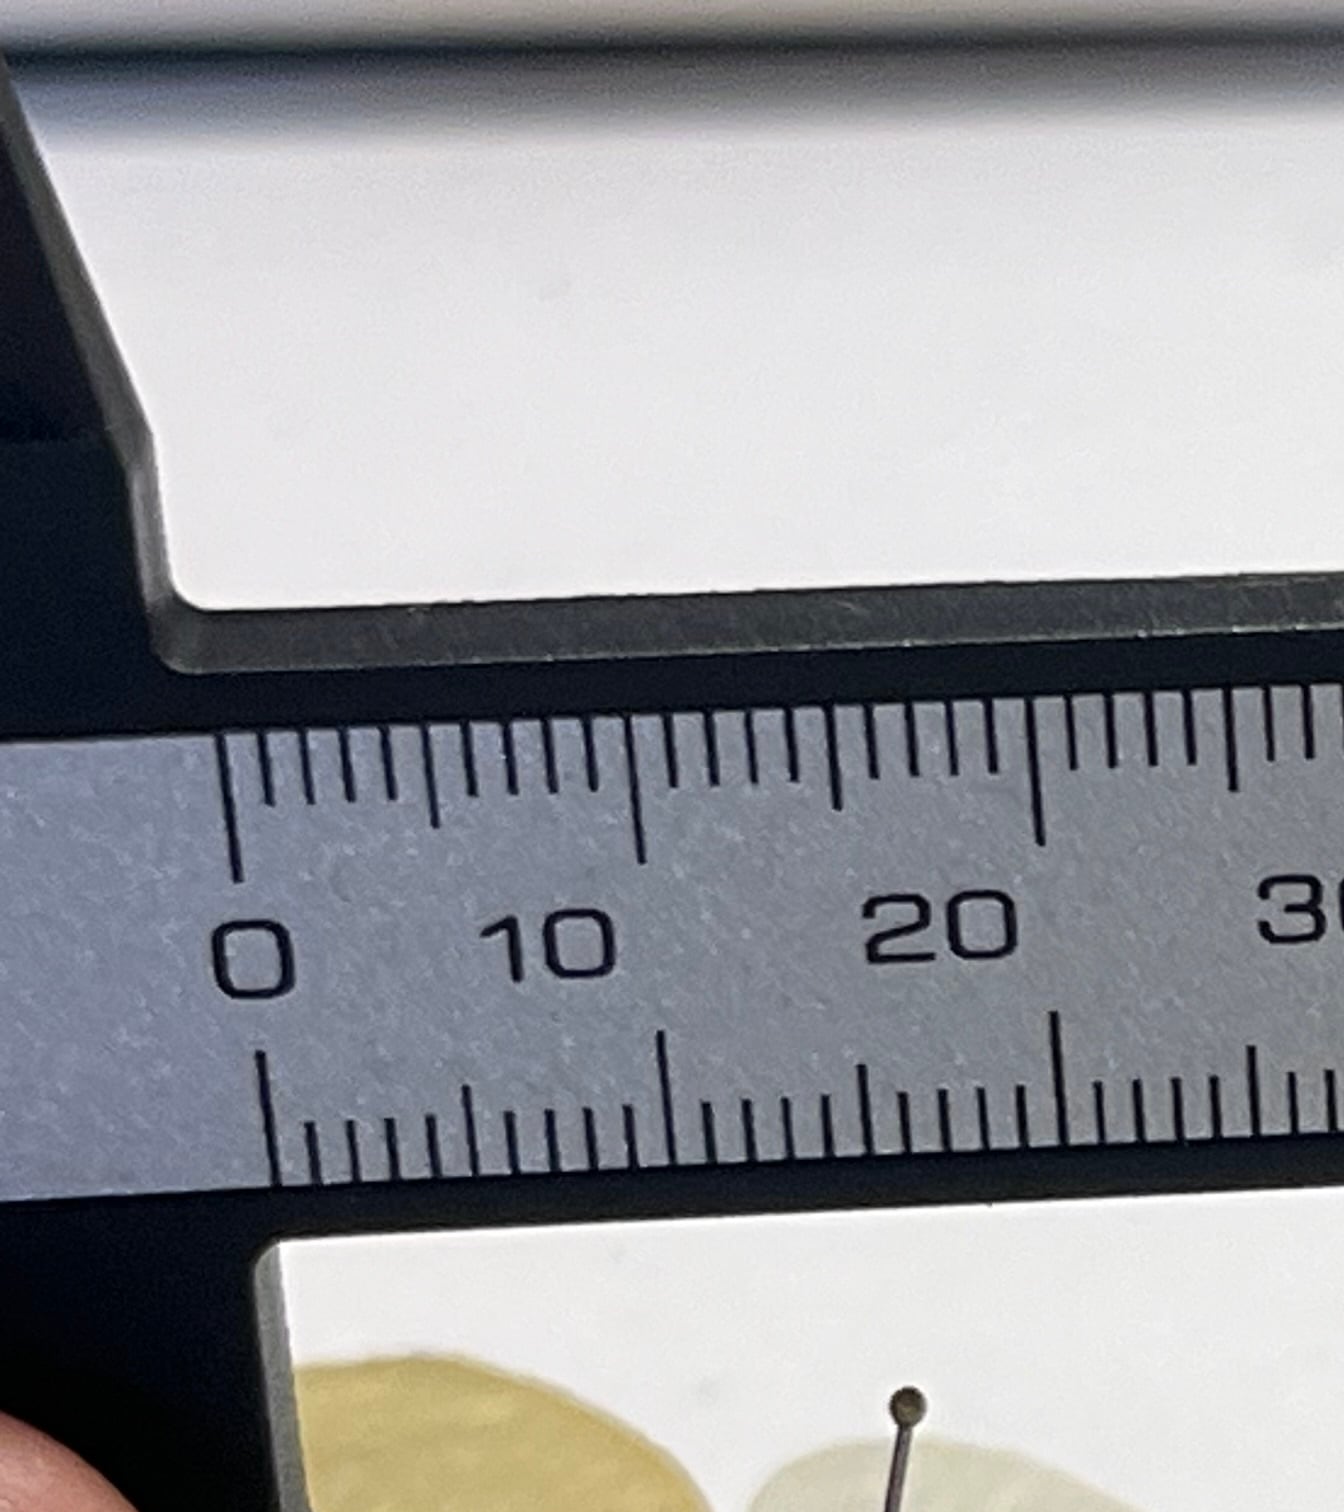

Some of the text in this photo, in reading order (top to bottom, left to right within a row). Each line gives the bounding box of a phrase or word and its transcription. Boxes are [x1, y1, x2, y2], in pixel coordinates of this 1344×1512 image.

[210, 918, 296, 1000] 0
[479, 907, 616, 983] 10
[861, 889, 1018, 965] 20
